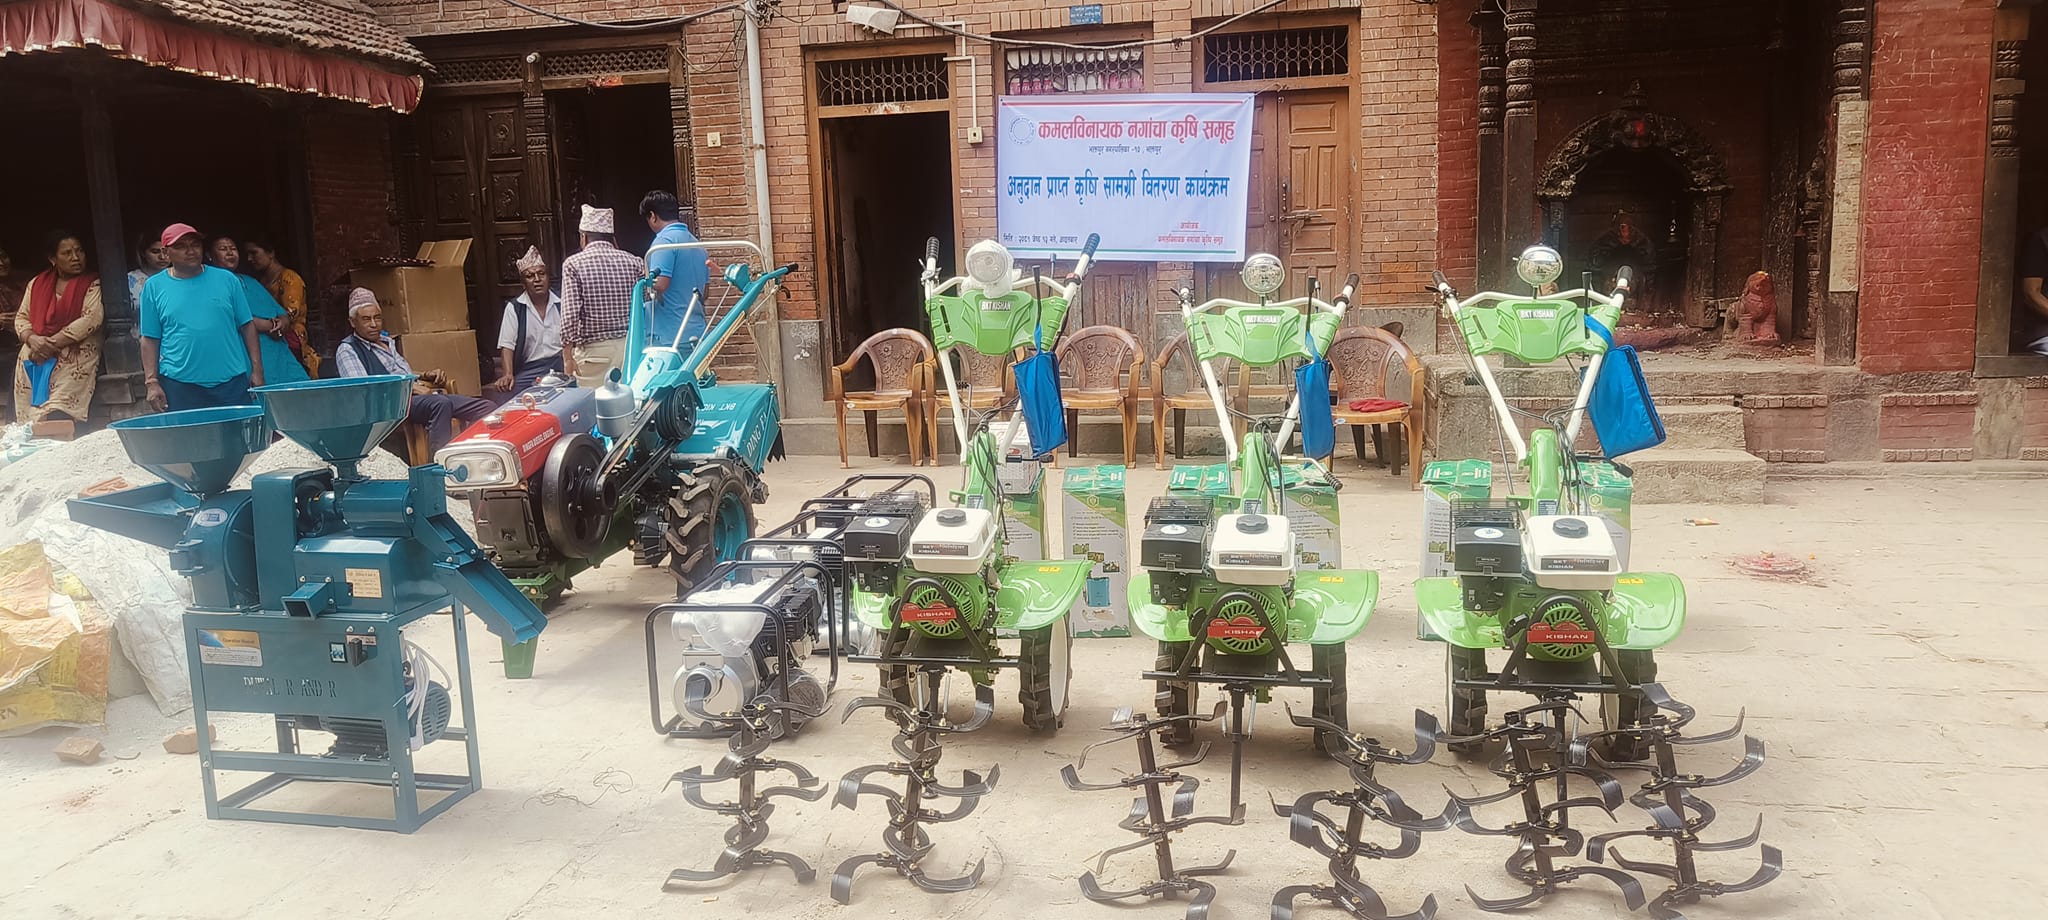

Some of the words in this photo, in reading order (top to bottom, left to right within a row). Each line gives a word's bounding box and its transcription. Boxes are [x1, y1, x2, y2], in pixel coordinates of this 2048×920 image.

[1038, 115, 1124, 140] कमलविनायक
[1170, 114, 1199, 144] कृषि
[1202, 119, 1236, 144] समूह
[1007, 175, 1042, 204] अनुदान
[1046, 176, 1070, 200] प्राप्त
[1075, 168, 1099, 205] कृषि
[1103, 169, 1137, 200] सामग्री
[1141, 168, 1181, 201] वितरण
[1185, 169, 1230, 200] कार्यक्रम
[718, 402, 737, 411] BKT
